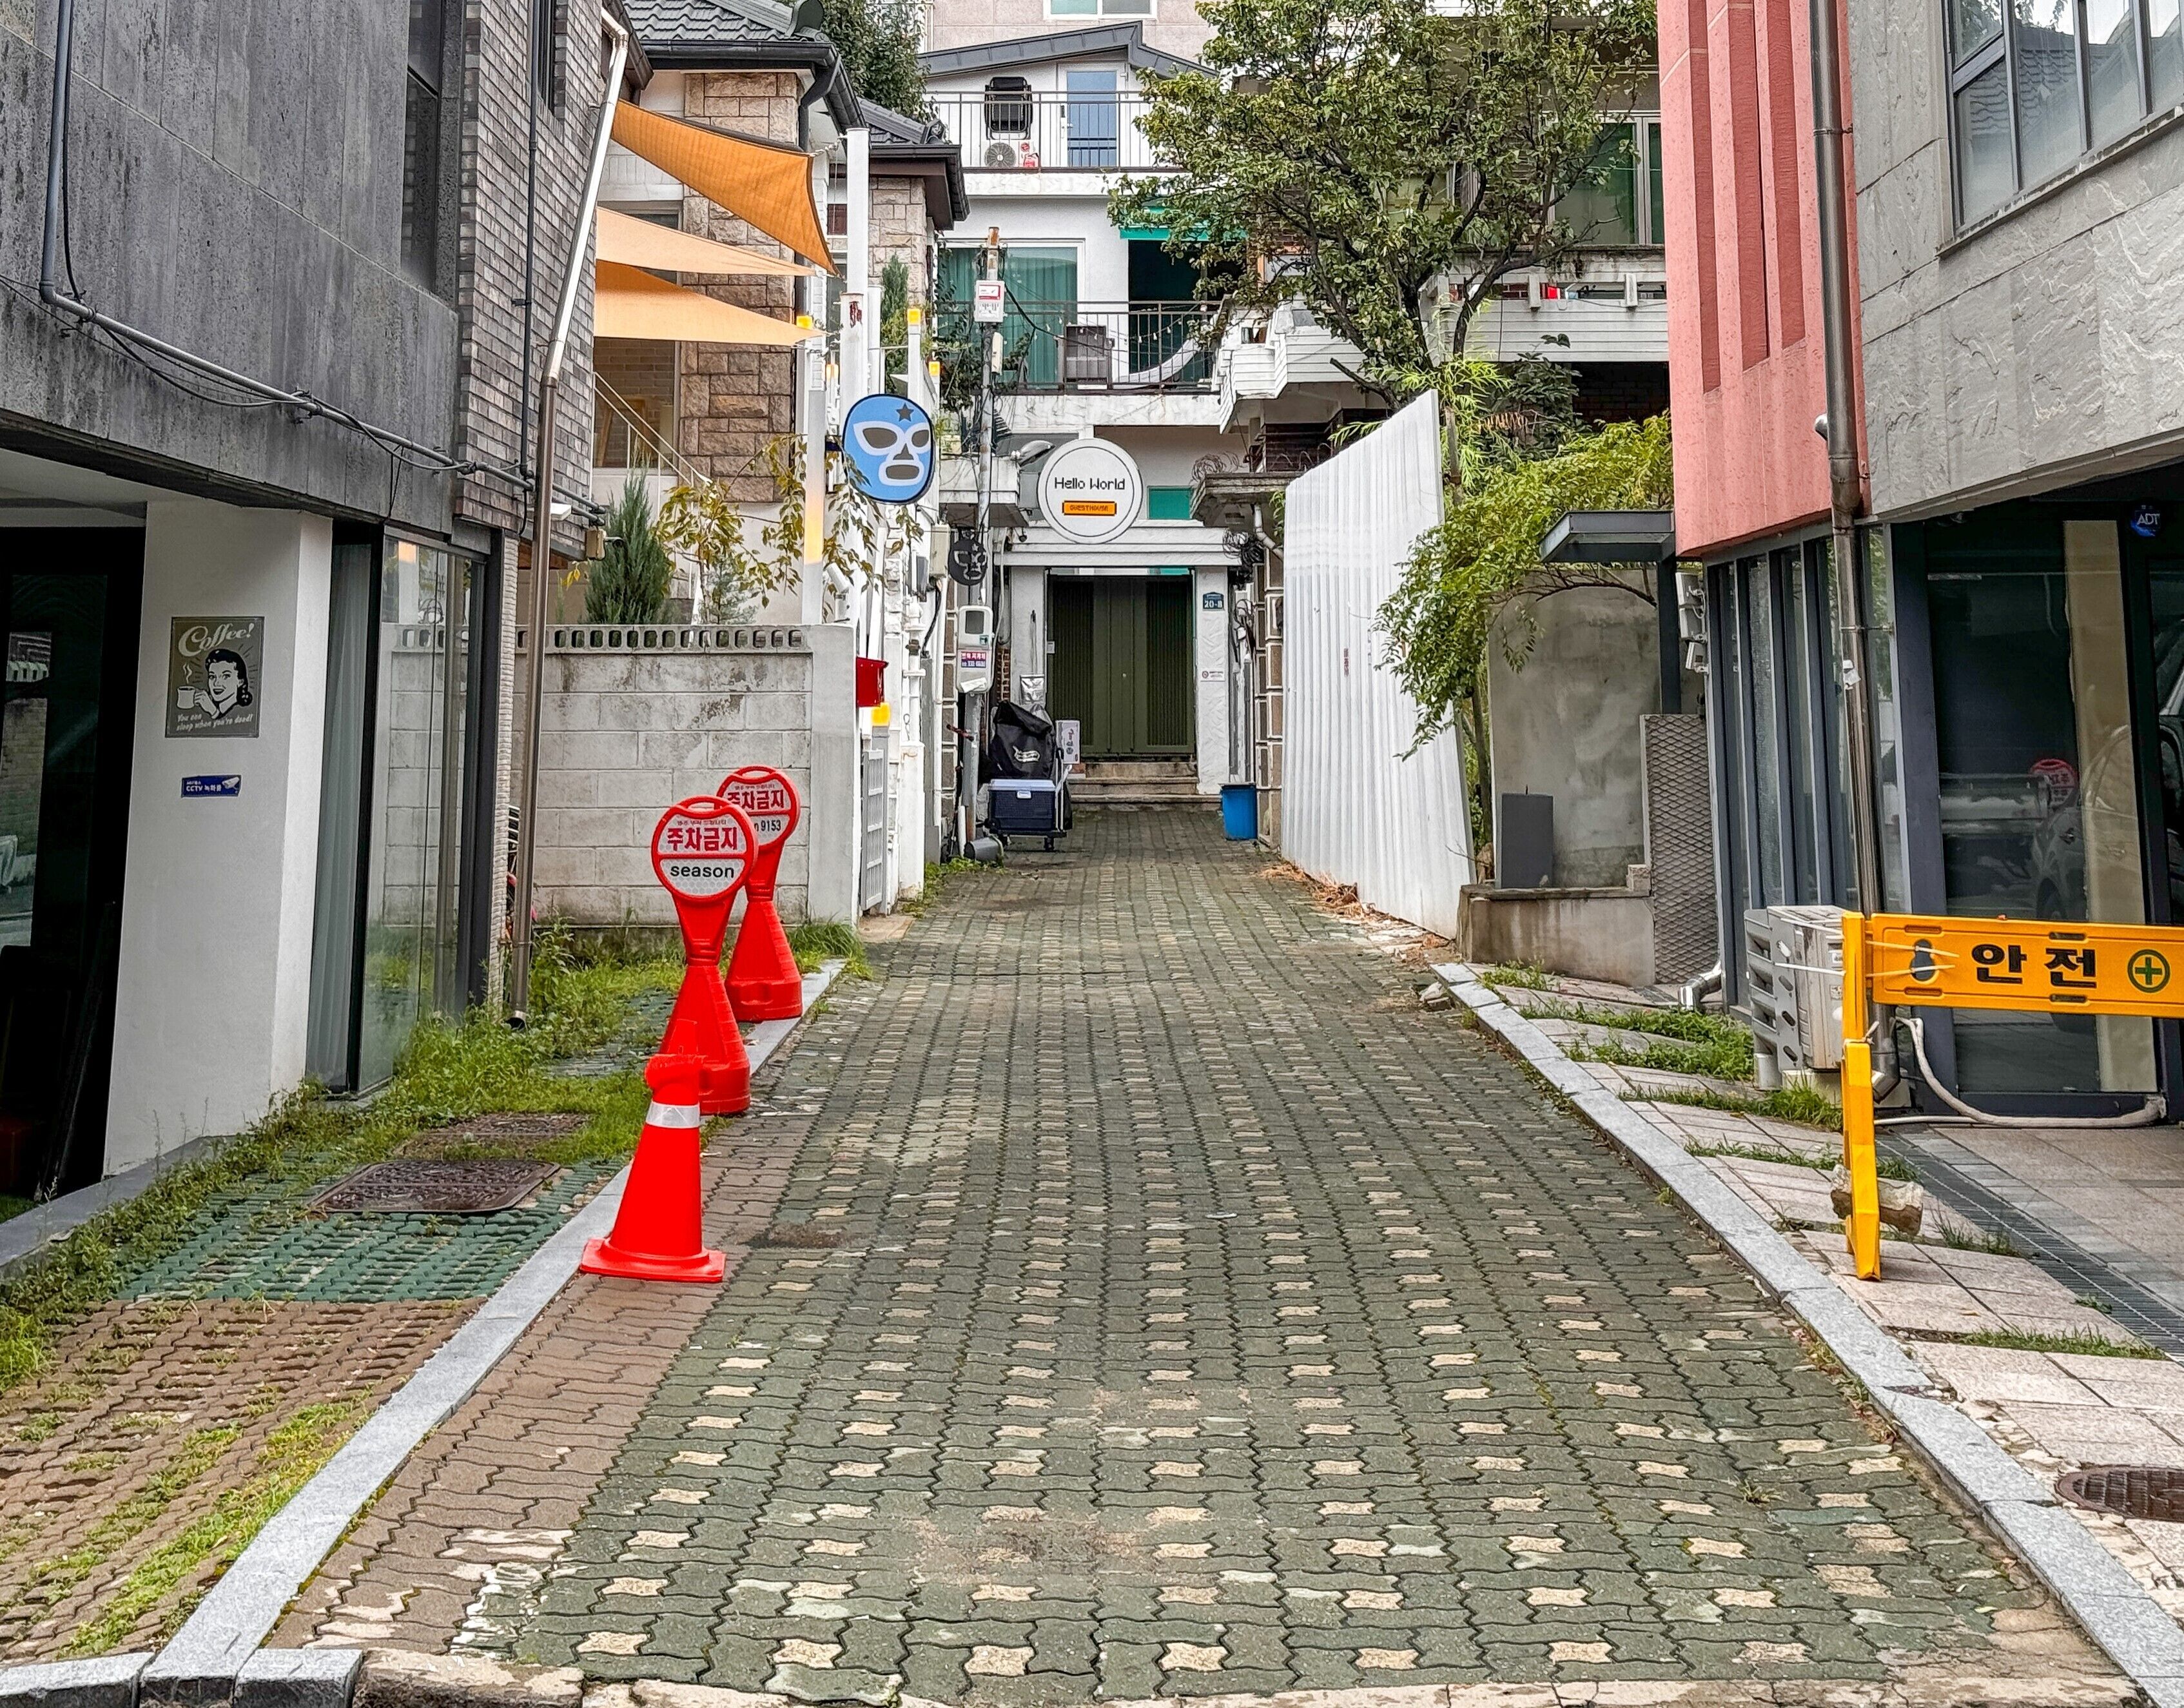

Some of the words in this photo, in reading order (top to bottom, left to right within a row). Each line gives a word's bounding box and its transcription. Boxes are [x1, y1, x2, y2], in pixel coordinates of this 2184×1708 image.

[1055, 477, 1086, 489] Hello
[1089, 478, 1126, 490] World
[2136, 513, 2160, 525] ADT
[178, 623, 255, 656] Coffee!
[727, 789, 784, 810] 주차금지
[761, 819, 781, 832] 9153
[667, 827, 737, 852] 주차금지
[670, 865, 734, 879] season
